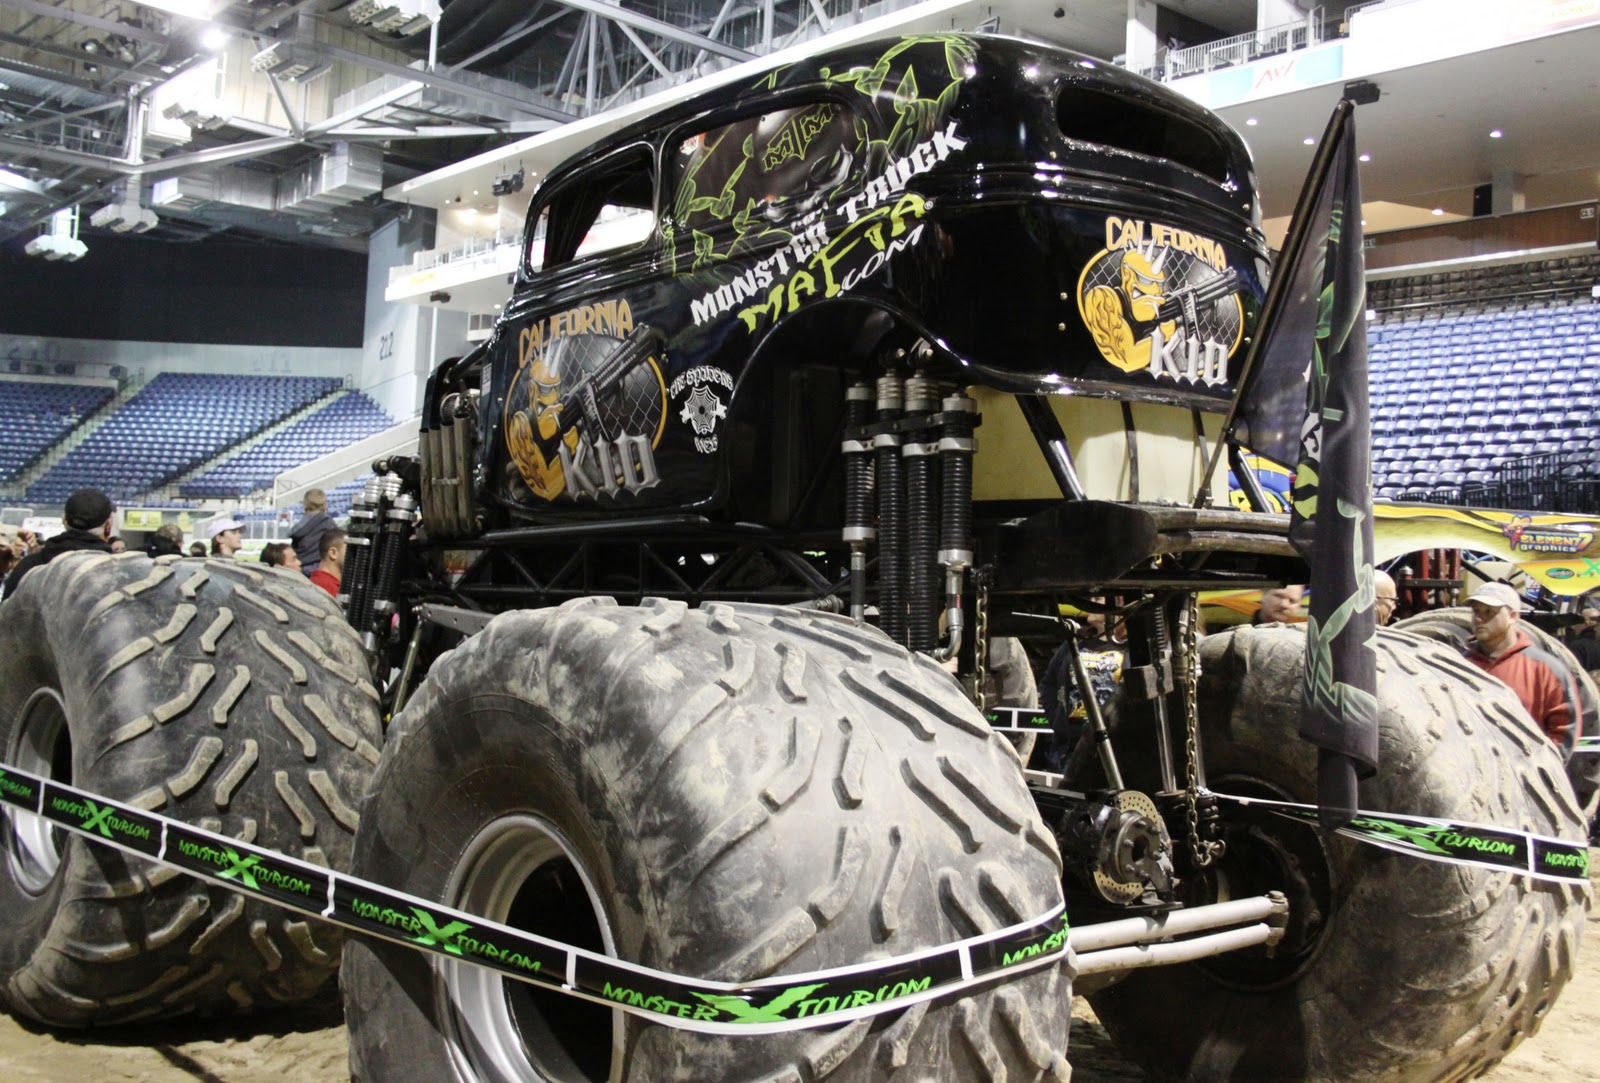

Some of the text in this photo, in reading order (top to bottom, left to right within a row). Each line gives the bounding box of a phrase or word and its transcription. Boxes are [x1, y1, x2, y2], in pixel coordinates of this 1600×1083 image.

[689, 121, 968, 326] MONSTER TRUCK
[1105, 216, 1227, 271] CALIFORNIA
[379, 330, 394, 361] 212
[518, 298, 634, 369] CALIFORNIA
[1150, 326, 1228, 388] KID
[557, 429, 662, 502] KID
[1520, 544, 1577, 552] graphics
